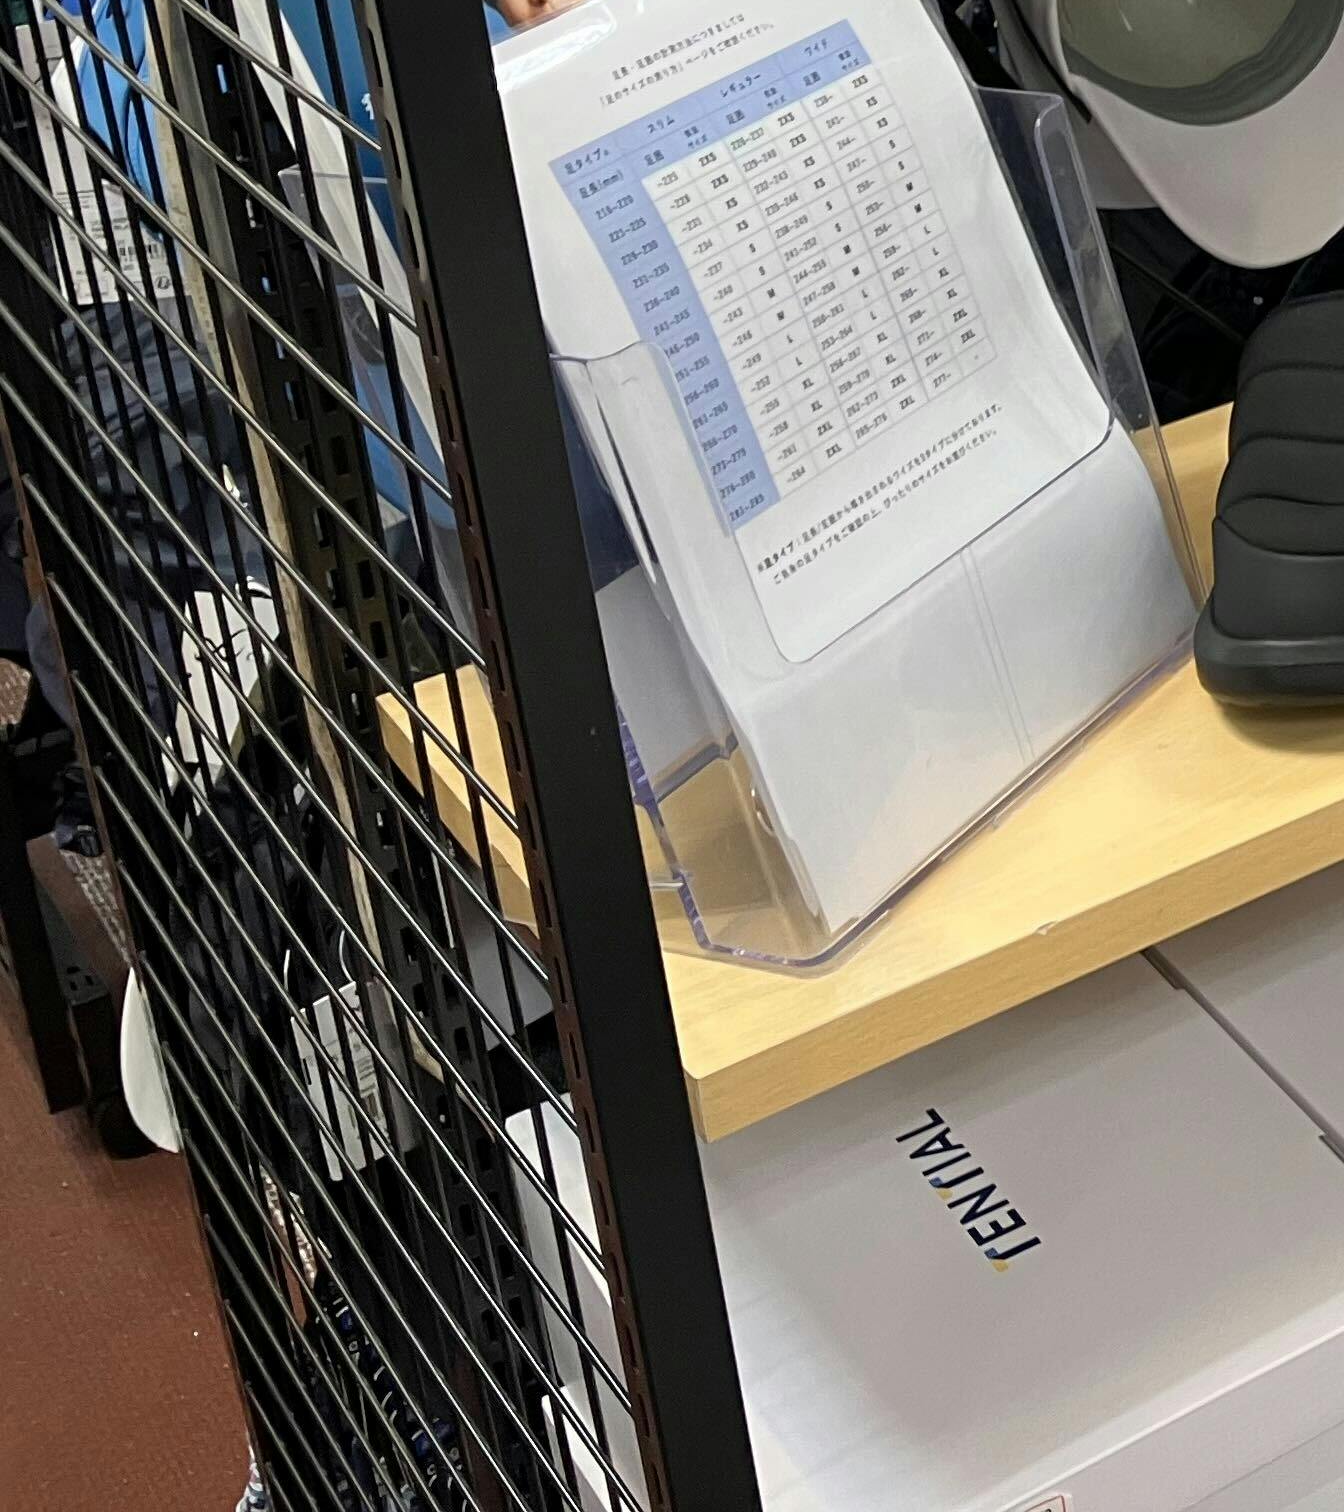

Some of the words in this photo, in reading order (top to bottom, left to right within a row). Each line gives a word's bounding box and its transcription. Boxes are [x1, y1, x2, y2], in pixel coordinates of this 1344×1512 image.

[697, 150, 718, 168] 2XS
[776, 110, 796, 128] 2XS
[850, 73, 870, 90] 2XS
[709, 171, 731, 190] 2XS
[788, 131, 808, 149] 2XS
[864, 94, 879, 109] XS
[723, 195, 739, 211] XS
[801, 154, 817, 169] XS
[875, 115, 889, 130] XS
[734, 217, 750, 234] XS
[812, 175, 827, 191] XS
[887, 137, 897, 150] S
[747, 241, 757, 254] S
[823, 199, 834, 212] S
[896, 159, 906, 172] S
[756, 264, 767, 277] S
[833, 221, 843, 233] S
[904, 180, 915, 193] M
[765, 286, 777, 300] M
[841, 242, 853, 256] M
[912, 201, 924, 215] M
[775, 309, 787, 322] M
[850, 264, 862, 277] M
[922, 223, 932, 236] L
[785, 333, 794, 345] L
[860, 287, 869, 299] L
[930, 245, 940, 257] L
[793, 354, 803, 367] L
[868, 309, 878, 321] L
[936, 265, 950, 280] XL
[800, 375, 815, 391] XL
[874, 329, 889, 345] XL
[945, 286, 959, 301] XL
[809, 398, 824, 414] XL
[882, 351, 897, 367] XL
[950, 305, 969, 324] 2XL
[815, 418, 834, 437] 2XL
[888, 371, 907, 390] 2XL
[958, 326, 976, 345] 2XL
[824, 440, 843, 460] 2XL
[897, 392, 916, 411] 2XL
[894, 1107, 1044, 1274] TENTIAL
